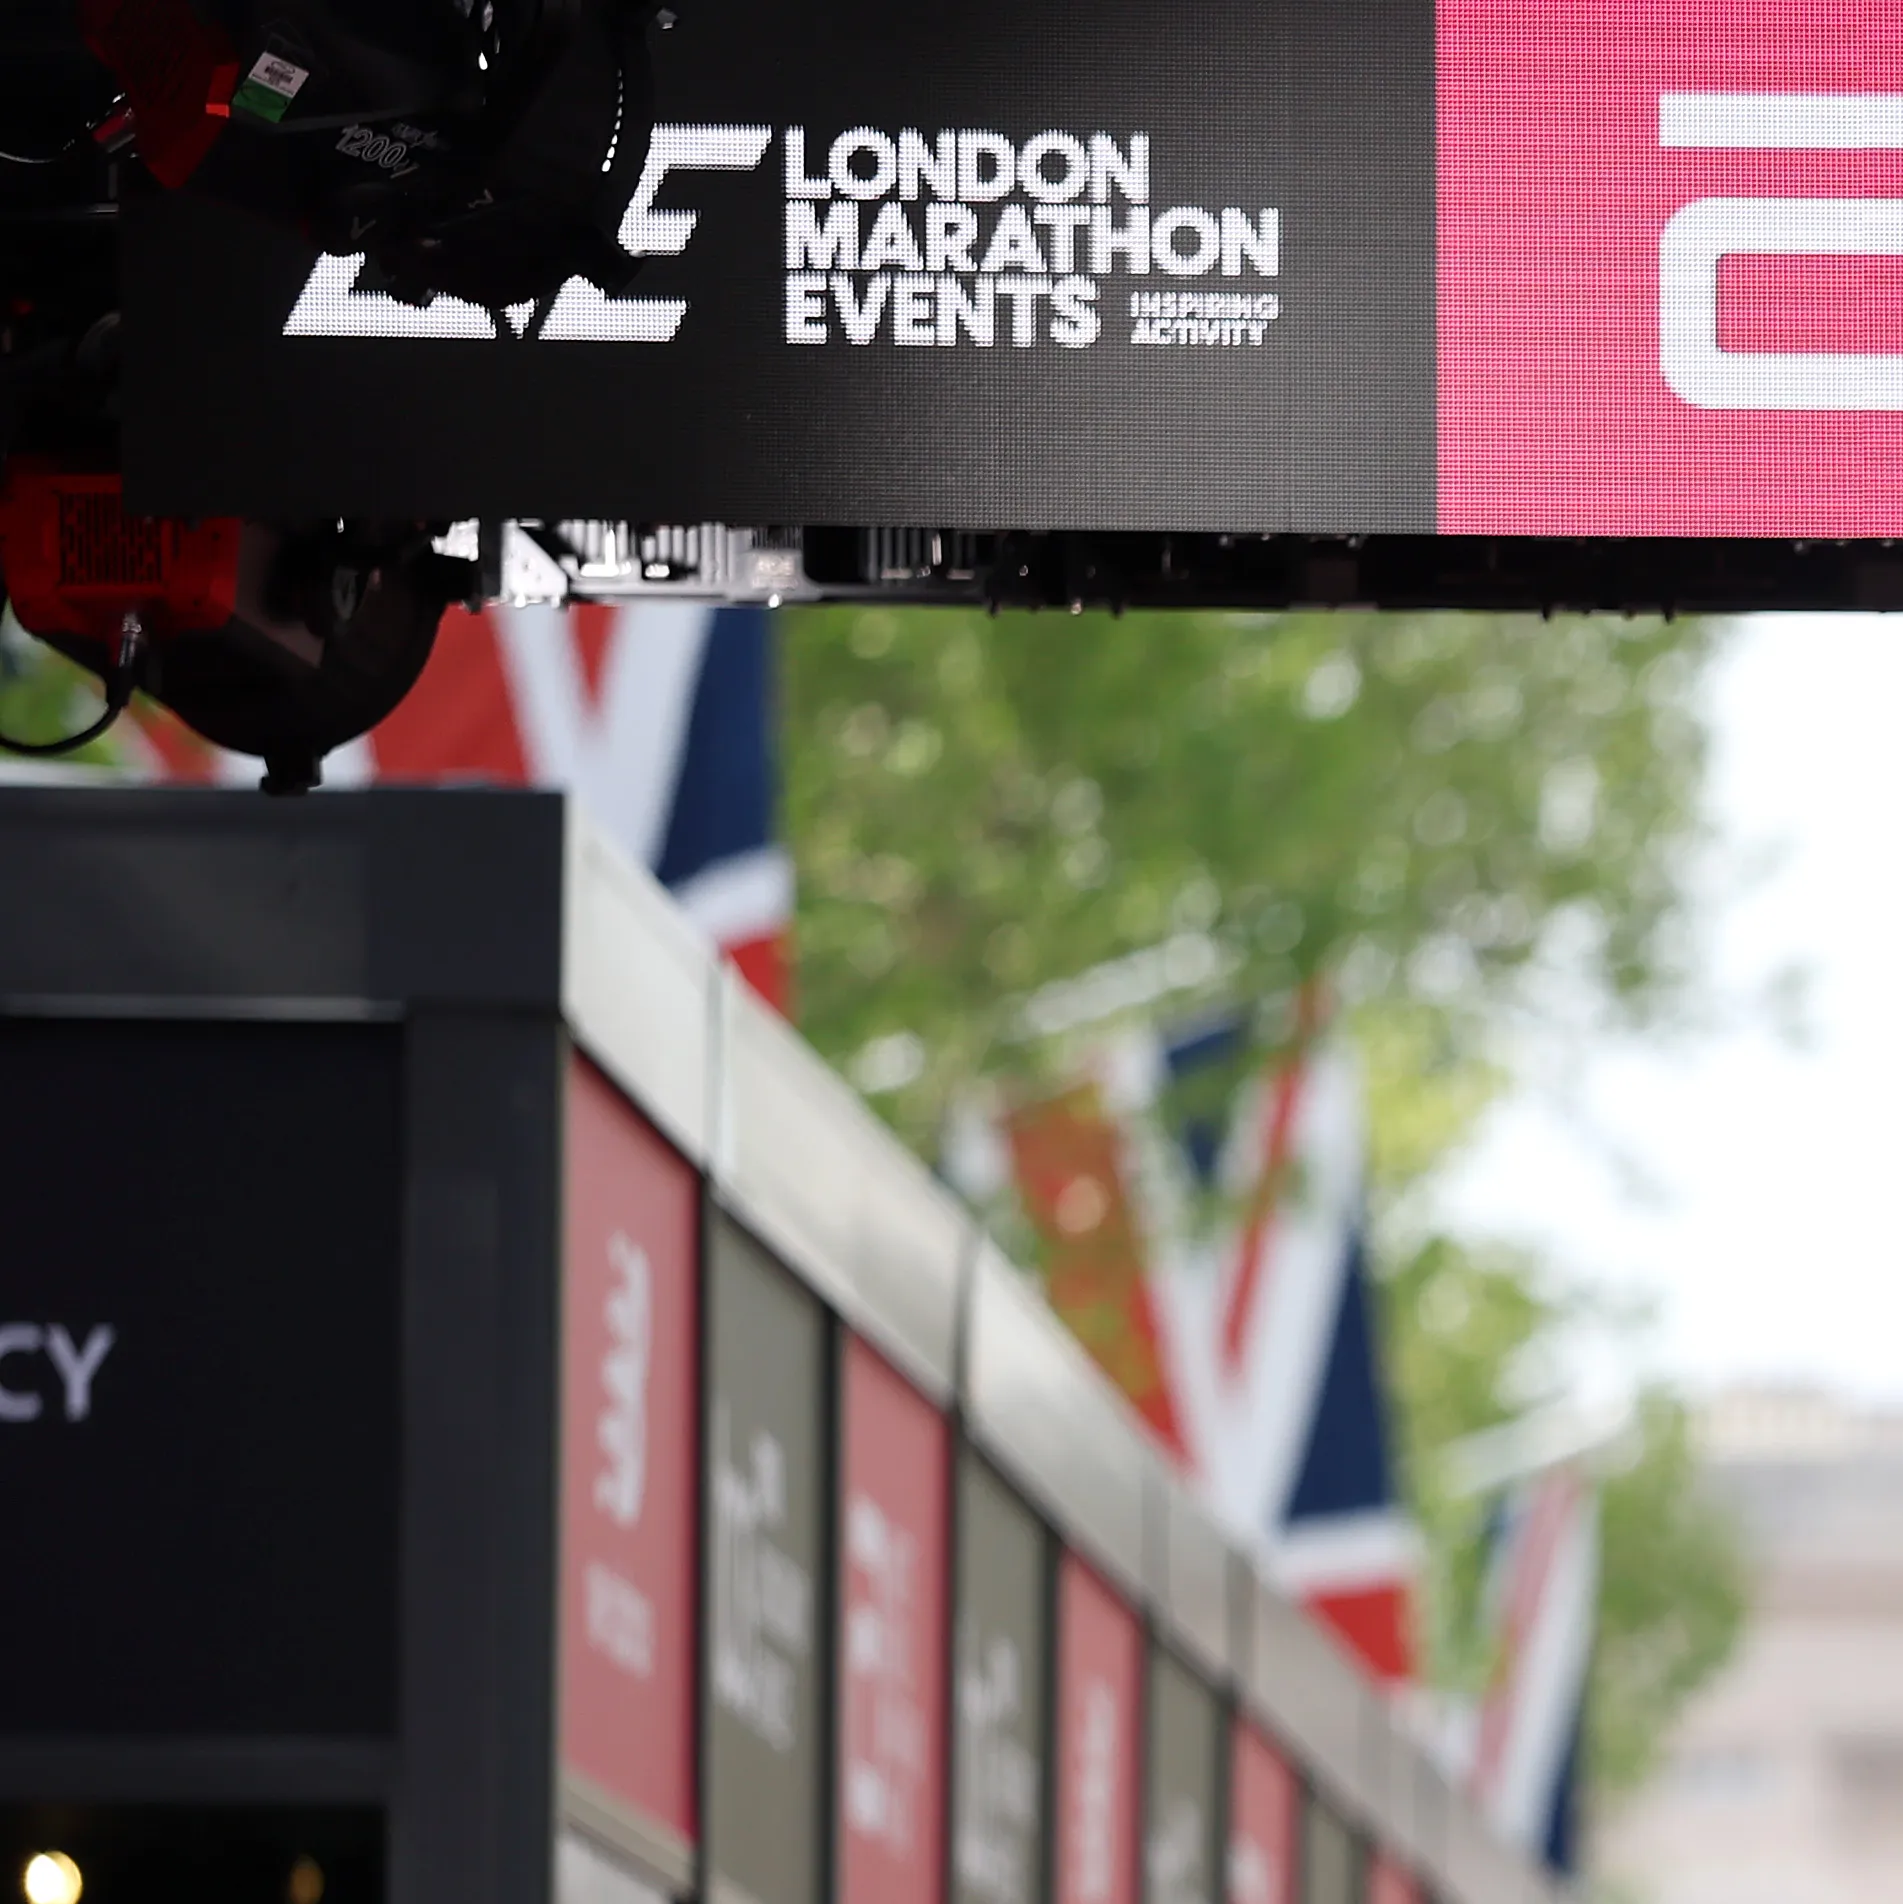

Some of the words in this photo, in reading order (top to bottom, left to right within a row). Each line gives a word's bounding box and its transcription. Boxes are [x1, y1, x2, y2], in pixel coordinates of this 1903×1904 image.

[785, 124, 1150, 204] LONDON
[785, 200, 1279, 277] MARATHON
[785, 270, 1101, 347] EVENTS
[1129, 317, 1268, 345] ACTIVITY
